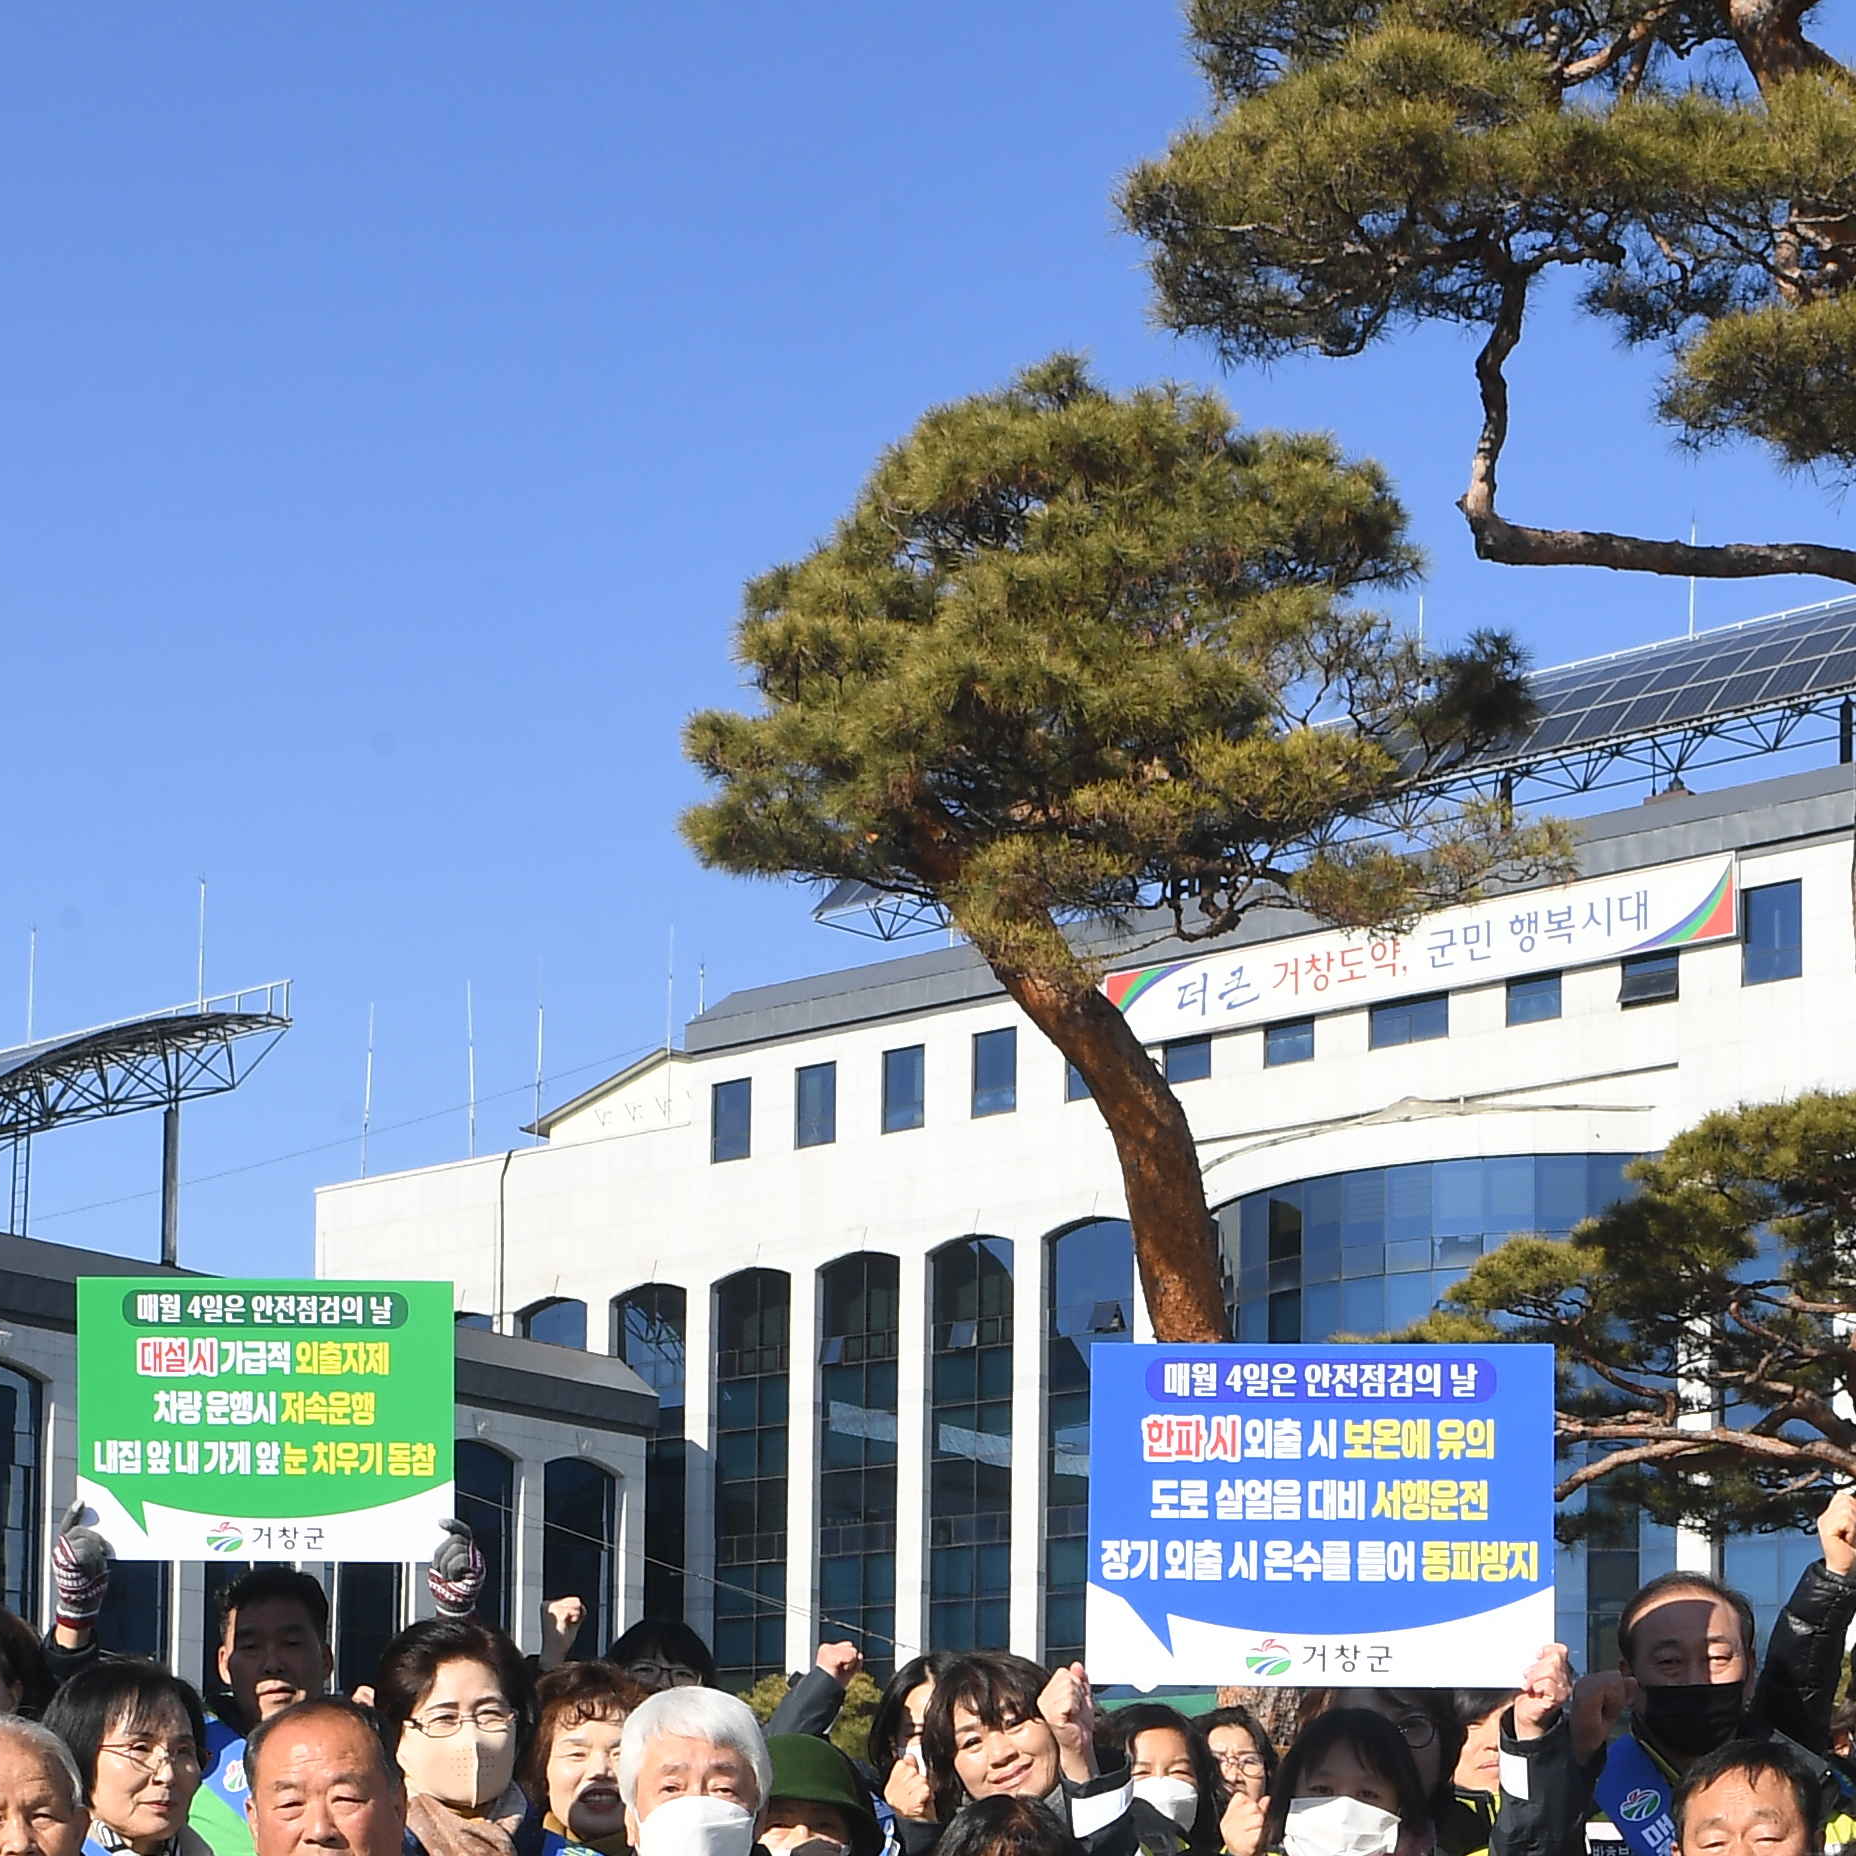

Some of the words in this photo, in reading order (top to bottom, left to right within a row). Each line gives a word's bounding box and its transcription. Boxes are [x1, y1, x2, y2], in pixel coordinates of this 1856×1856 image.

[1177, 971, 1208, 1017] 더
[1219, 964, 1260, 1010] 큰
[1273, 936, 1408, 997] 거창도약,
[1426, 920, 1492, 968] 군민
[1510, 889, 1649, 954] 행복시대
[136, 1294, 181, 1323] 매월
[187, 1295, 245, 1323] 4일은
[251, 1296, 363, 1325] 안전점검의
[370, 1296, 392, 1325] 날
[1164, 1363, 1217, 1397] 매월
[1226, 1363, 1296, 1397] 4일은
[1304, 1363, 1441, 1397] 안전점검의
[1451, 1363, 1477, 1397] 날
[154, 1391, 200, 1425] 차량
[207, 1392, 277, 1425] 운행시
[281, 1392, 376, 1425] 저속운행
[1145, 1417, 1203, 1459] 한파
[1207, 1417, 1240, 1460] 시
[1245, 1419, 1302, 1459] 외출
[1308, 1419, 1336, 1459] 시
[1344, 1419, 1431, 1459] 보온에
[1437, 1419, 1494, 1459] 유의
[94, 1441, 141, 1474] 내집
[147, 1441, 170, 1474] 앞
[176, 1441, 198, 1475] 내
[204, 1441, 251, 1475] 가게
[256, 1442, 279, 1475] 앞
[284, 1442, 307, 1475] 눈
[314, 1442, 382, 1476] 치우기
[388, 1443, 436, 1476] 동참
[1151, 1480, 1208, 1520] 도로
[1216, 1480, 1301, 1520] 살얼음
[1308, 1480, 1365, 1520] 대비
[1372, 1480, 1488, 1520] 서행운전
[252, 1527, 326, 1550] 거창군
[1101, 1540, 1159, 1581] 장기
[1165, 1540, 1222, 1581] 외출
[1229, 1540, 1257, 1581] 시
[1264, 1540, 1351, 1581] 온수를
[1357, 1540, 1415, 1581] 틀어
[1421, 1540, 1538, 1581] 동파방지
[1302, 1645, 1393, 1673] 거창군
